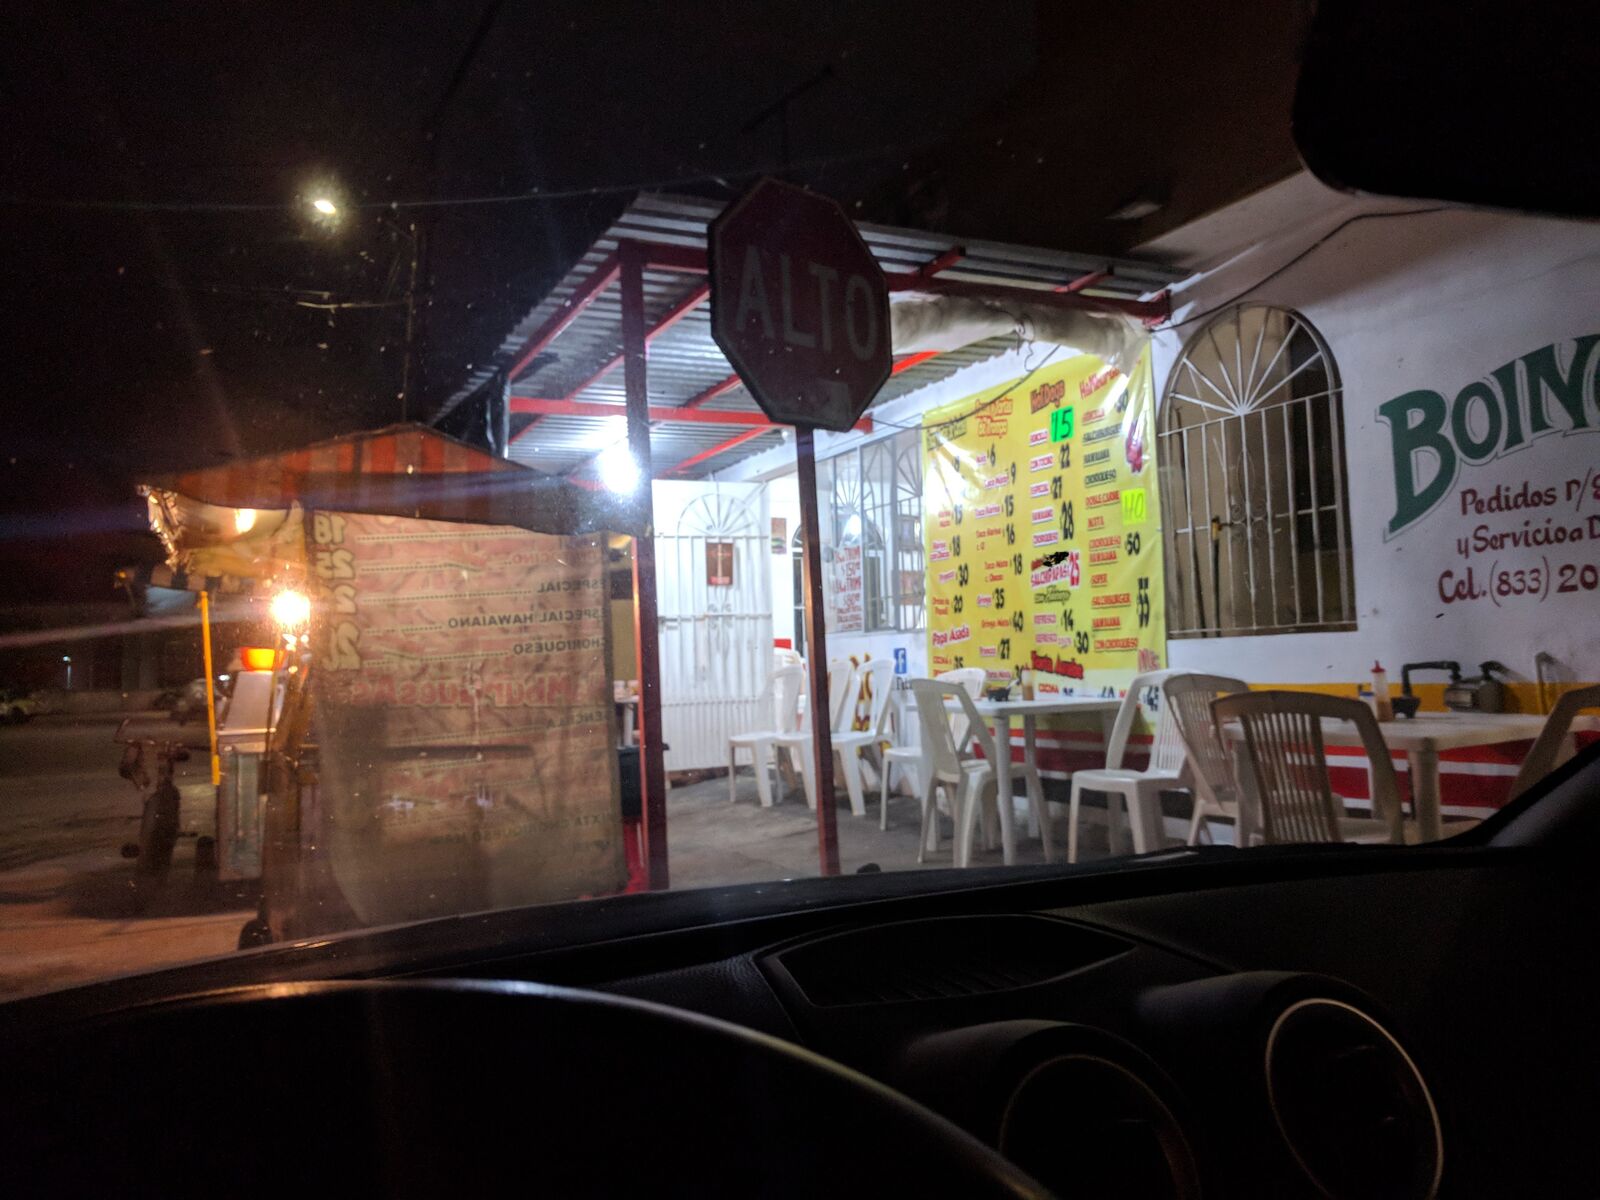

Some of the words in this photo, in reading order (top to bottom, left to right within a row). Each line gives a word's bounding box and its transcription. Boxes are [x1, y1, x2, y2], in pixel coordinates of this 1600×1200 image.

[735, 246, 878, 361] ALTO
[1378, 333, 1600, 534] BOIN
[1460, 480, 1557, 515] Pedidos
[1438, 566, 1487, 603] Cel.
[1490, 555, 1549, 608] (833)
